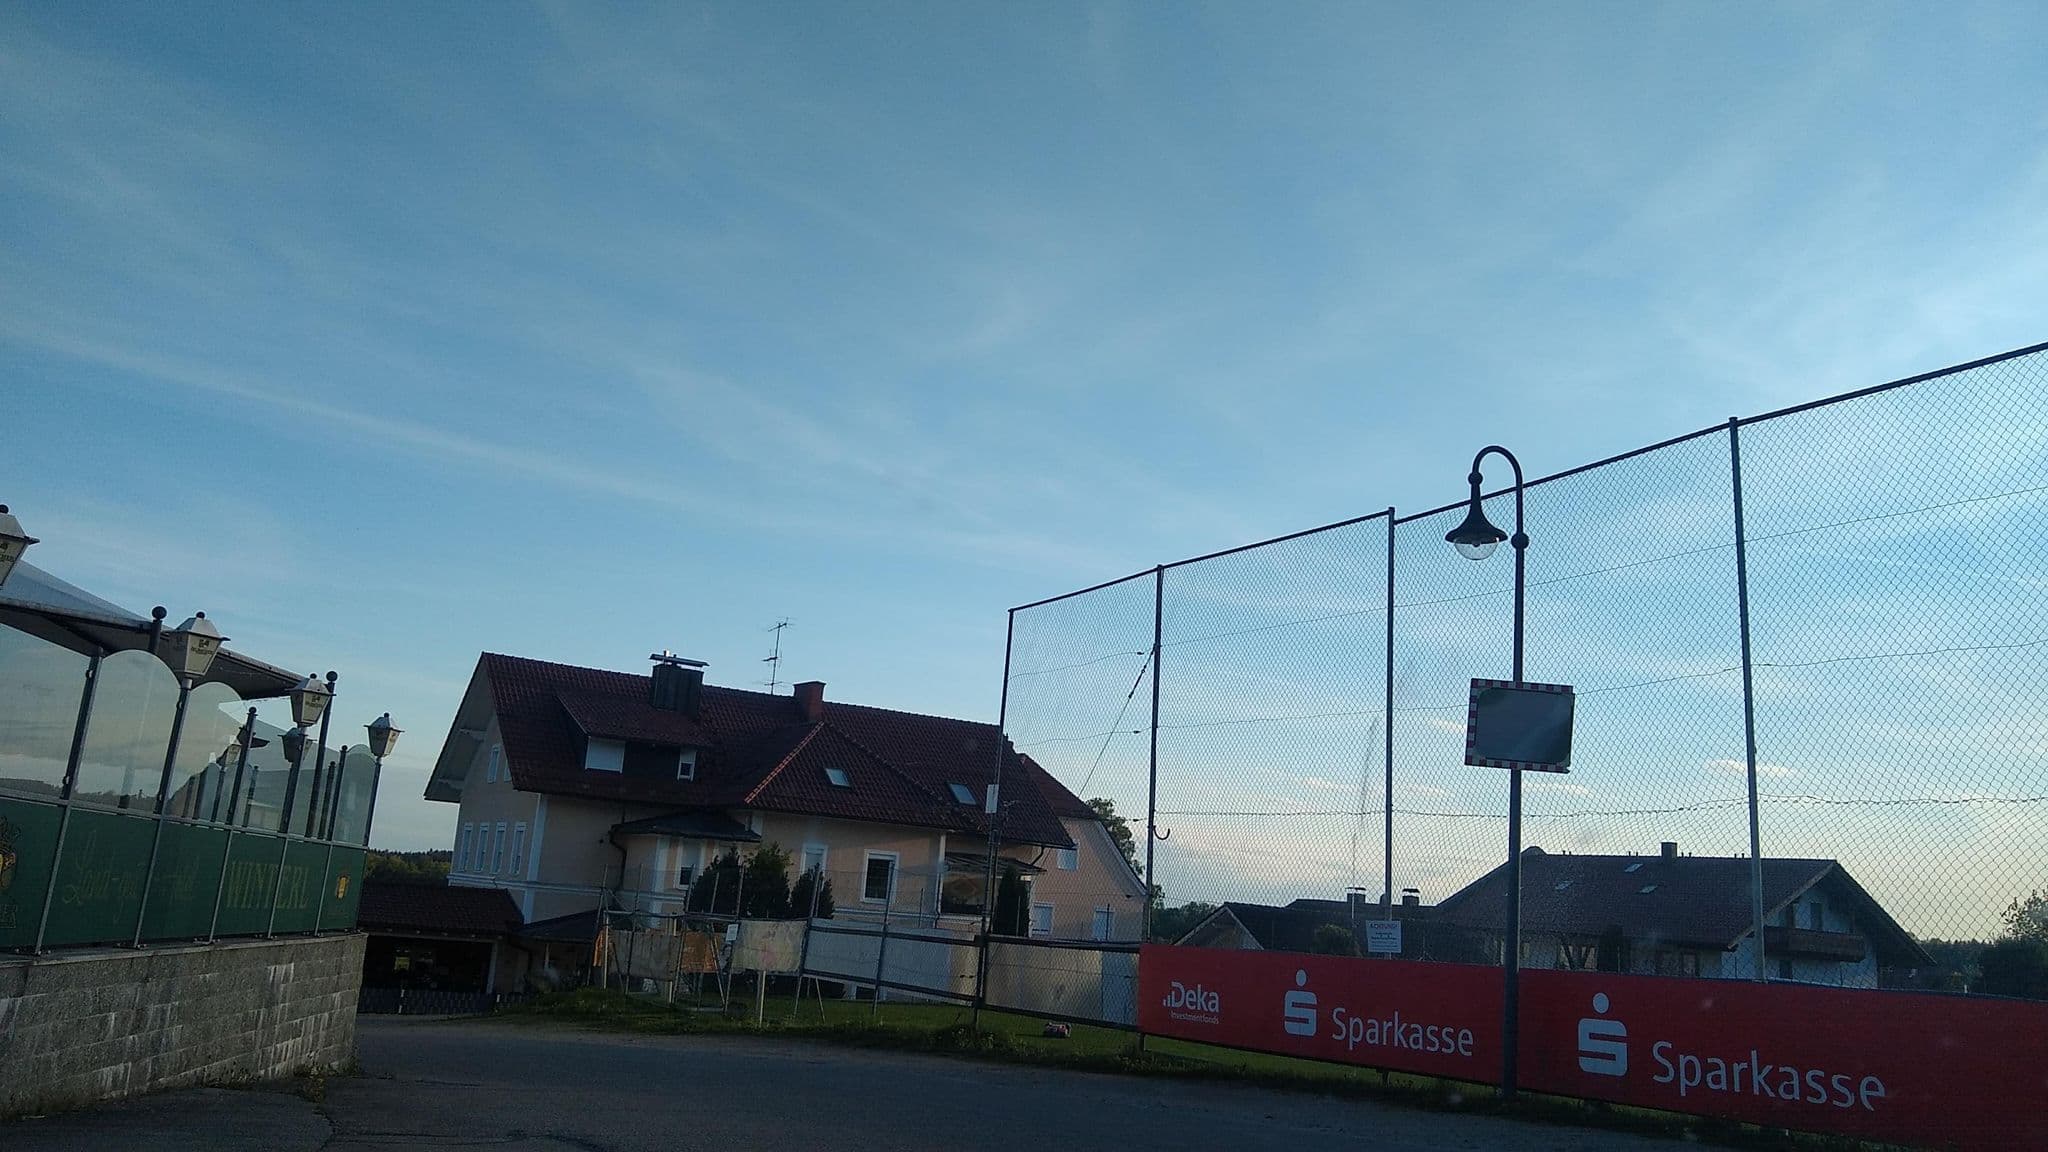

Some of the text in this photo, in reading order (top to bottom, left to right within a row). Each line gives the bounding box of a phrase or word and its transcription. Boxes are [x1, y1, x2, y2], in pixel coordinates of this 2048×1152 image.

[1166, 981, 1220, 1013] Deka
[1331, 1007, 1475, 1057] Sparkasse
[1652, 1040, 1887, 1112] Sparkasse
